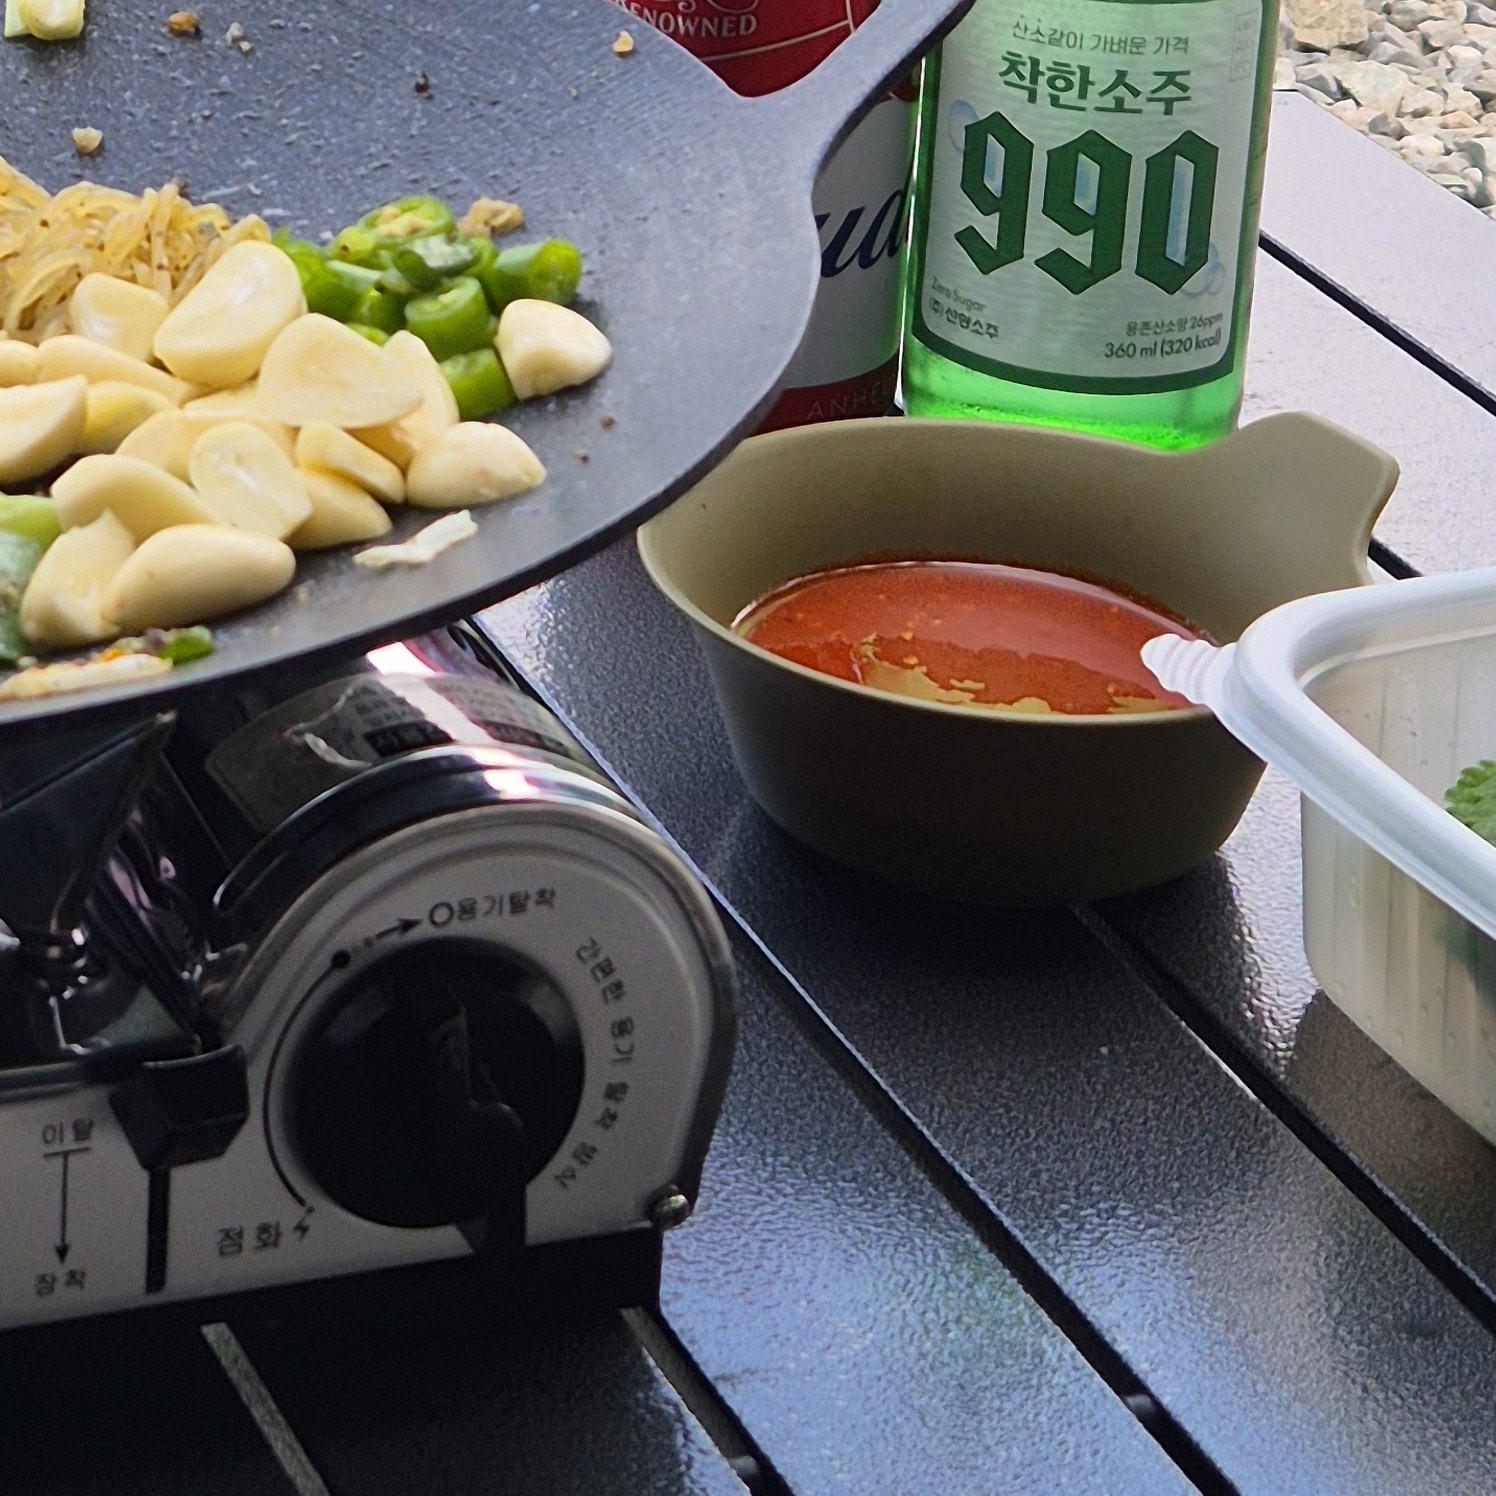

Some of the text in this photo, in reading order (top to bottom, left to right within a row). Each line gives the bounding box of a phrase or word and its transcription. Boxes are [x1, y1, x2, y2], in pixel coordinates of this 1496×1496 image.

[1012, 17, 1189, 55] 산소같이 가벼운 가격
[999, 50, 1192, 115] 착한소주
[954, 111, 1219, 295] 990
[1104, 342, 1137, 358] 360
[1140, 340, 1157, 357] ml
[1161, 337, 1192, 357] (320
